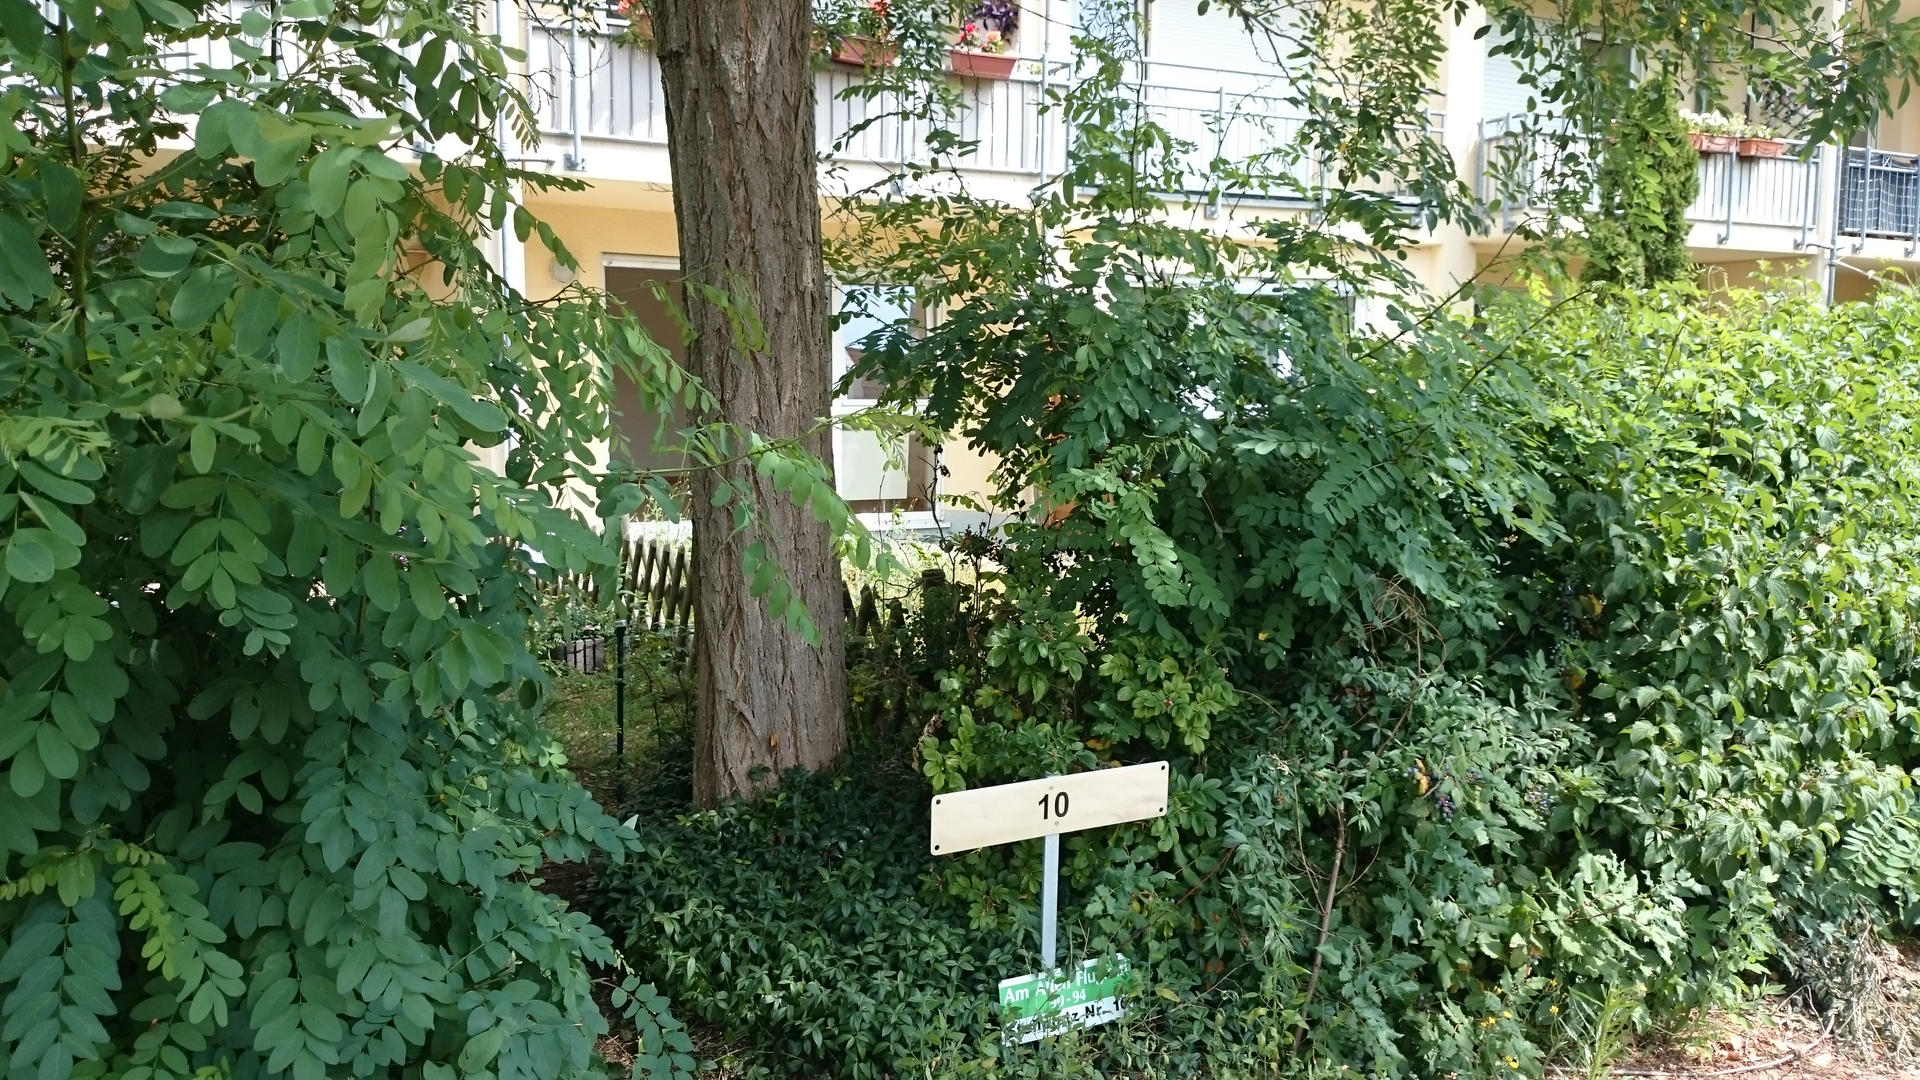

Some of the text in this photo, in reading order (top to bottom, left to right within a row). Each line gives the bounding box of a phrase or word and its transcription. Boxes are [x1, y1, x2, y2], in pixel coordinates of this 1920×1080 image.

[1038, 791, 1069, 820] 10
[1004, 987, 1029, 1004] Am
[1072, 988, 1087, 1003] 94
